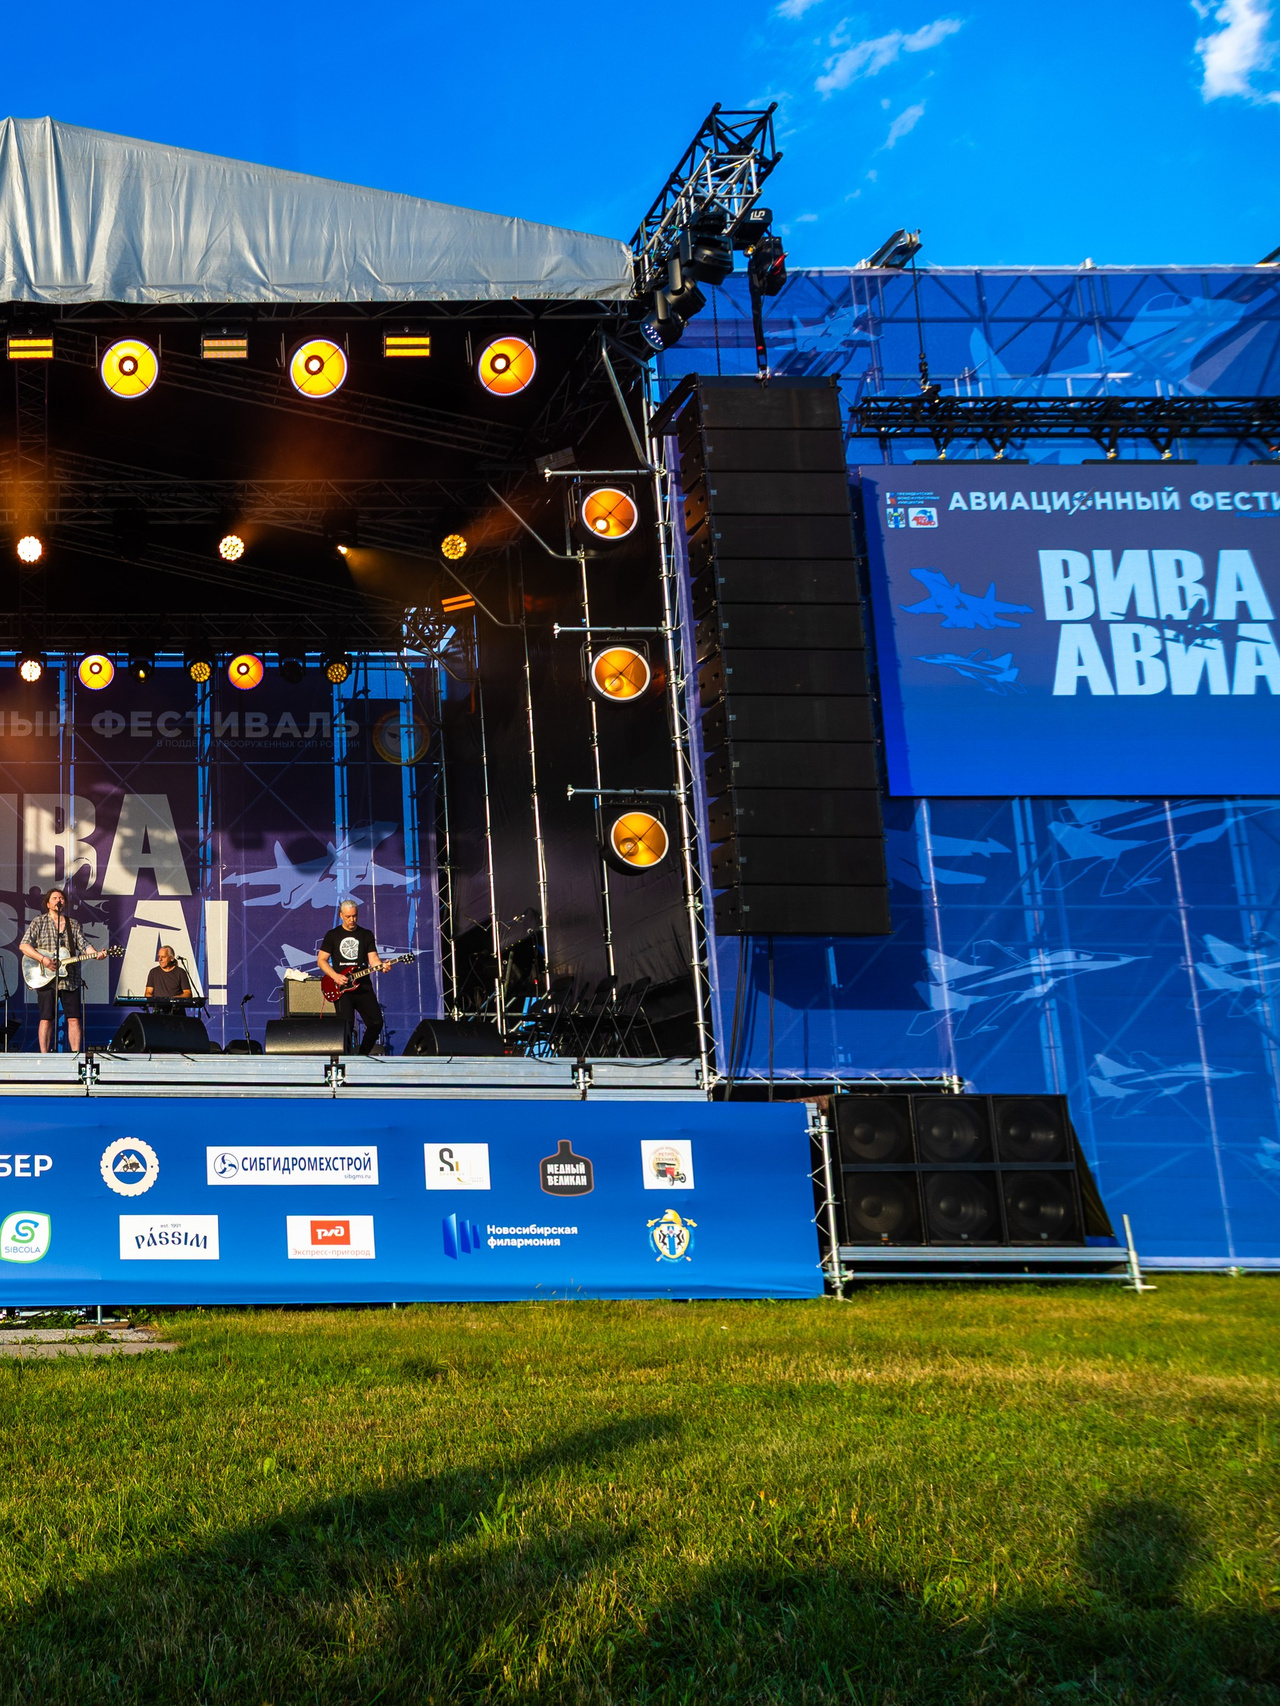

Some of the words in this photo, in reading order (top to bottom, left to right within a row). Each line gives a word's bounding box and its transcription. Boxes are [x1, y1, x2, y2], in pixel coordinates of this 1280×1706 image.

[948, 487, 1182, 514] АВИАЦИОННЫЙ
[1038, 549, 1275, 621] ВИВА
[91, 710, 360, 738] ФЕСТИВАЛЬ
[165, 740, 221, 749] ПОДДЕКУ
[320, 740, 360, 748] РОИИ
[241, 1152, 372, 1174] СИБГИДРОМЕХСТРОЙ
[547, 1162, 586, 1174] МЕДНЫЙ
[546, 1175, 587, 1186] ВЕЛИКАН
[487, 1224, 578, 1237] Новосибирская
[487, 1236, 561, 1249] филармония
[292, 1248, 371, 1257] Экспресс-пригород
